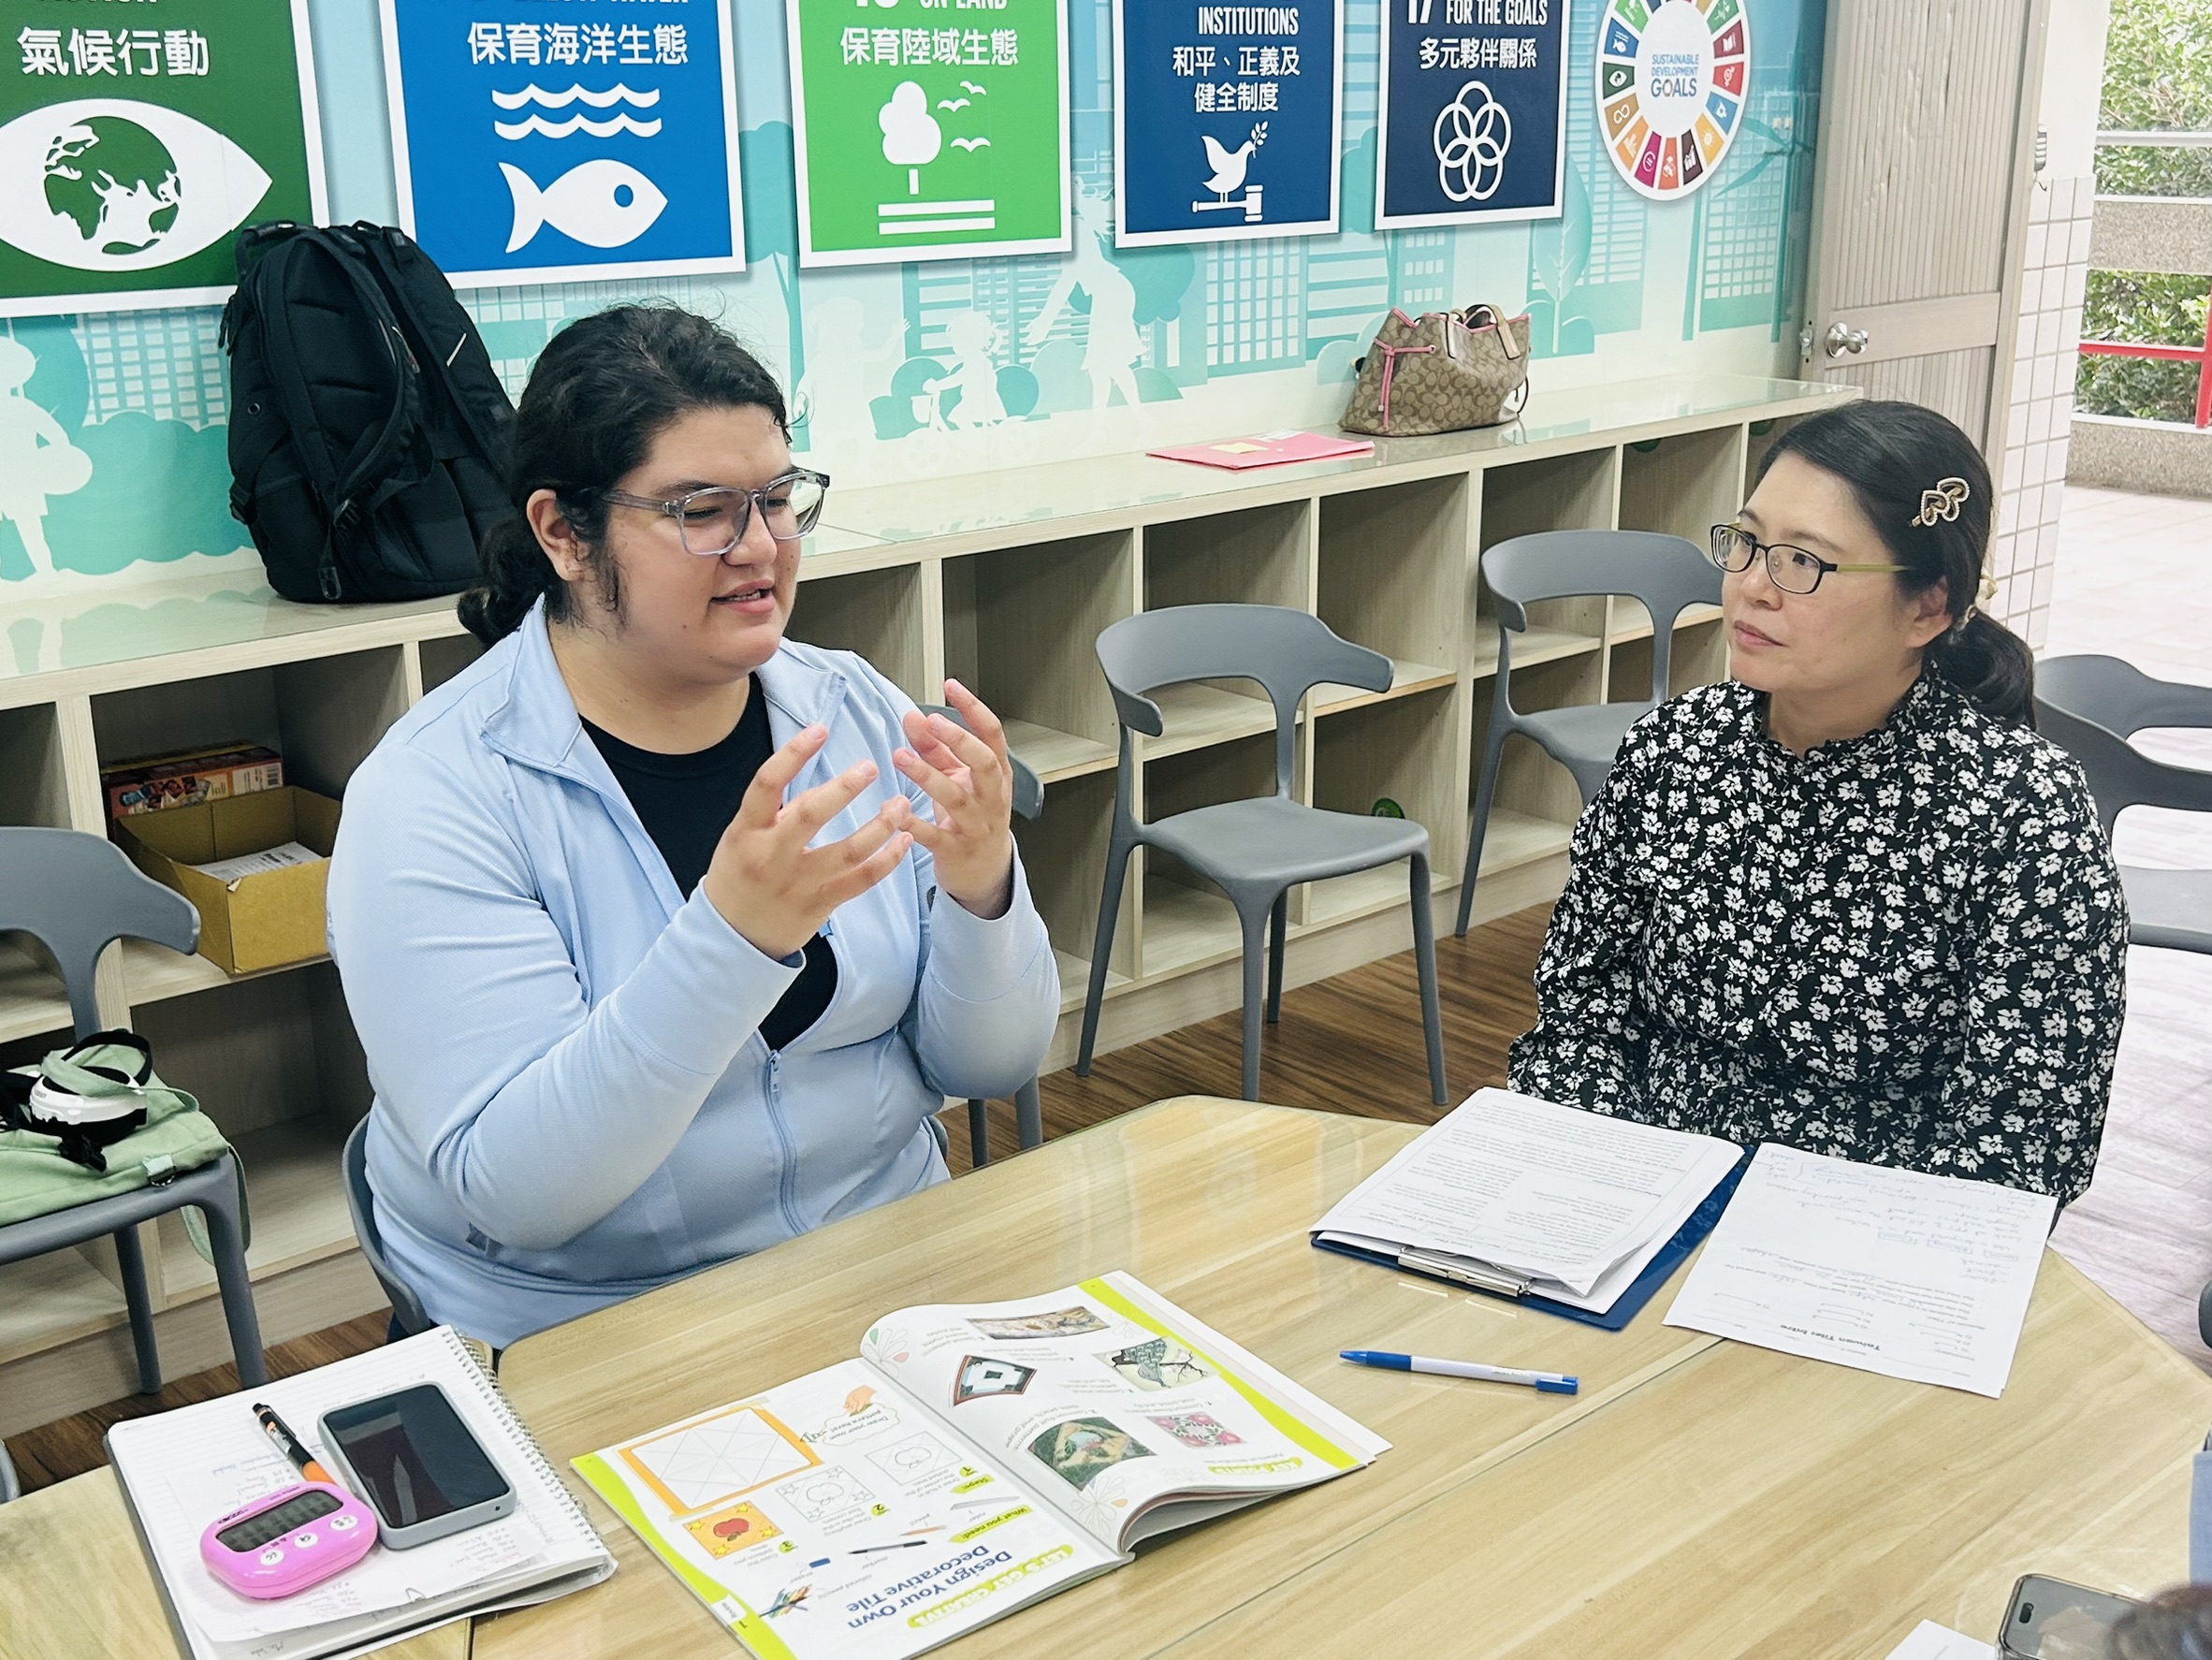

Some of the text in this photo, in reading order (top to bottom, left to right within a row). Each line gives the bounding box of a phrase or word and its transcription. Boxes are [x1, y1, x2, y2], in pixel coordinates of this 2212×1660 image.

[1198, 7, 1299, 36] INSTITUTIONS
[1446, 0, 1473, 24] FOR
[1477, 0, 1502, 24] THE
[1505, 0, 1549, 25] GOALS
[17, 26, 211, 77] 氣候行動
[468, 22, 689, 66] 保育海洋生態
[840, 27, 1019, 66] 保育陸域生態
[1419, 36, 1537, 70] 多元夥伴關係
[1652, 53, 1699, 65] SUSTAINABLE
[1172, 46, 1301, 77] 和平、正義及
[1651, 66, 1698, 77] DEVELOPMENT
[1194, 81, 1279, 113] 健全制度
[1651, 78, 1697, 97] GOALS
[986, 1516, 1002, 1527] you
[1003, 1507, 1027, 1521] What
[846, 1545, 990, 1612] Decorative Tile
[847, 1551, 1012, 1629] Design Your Own
